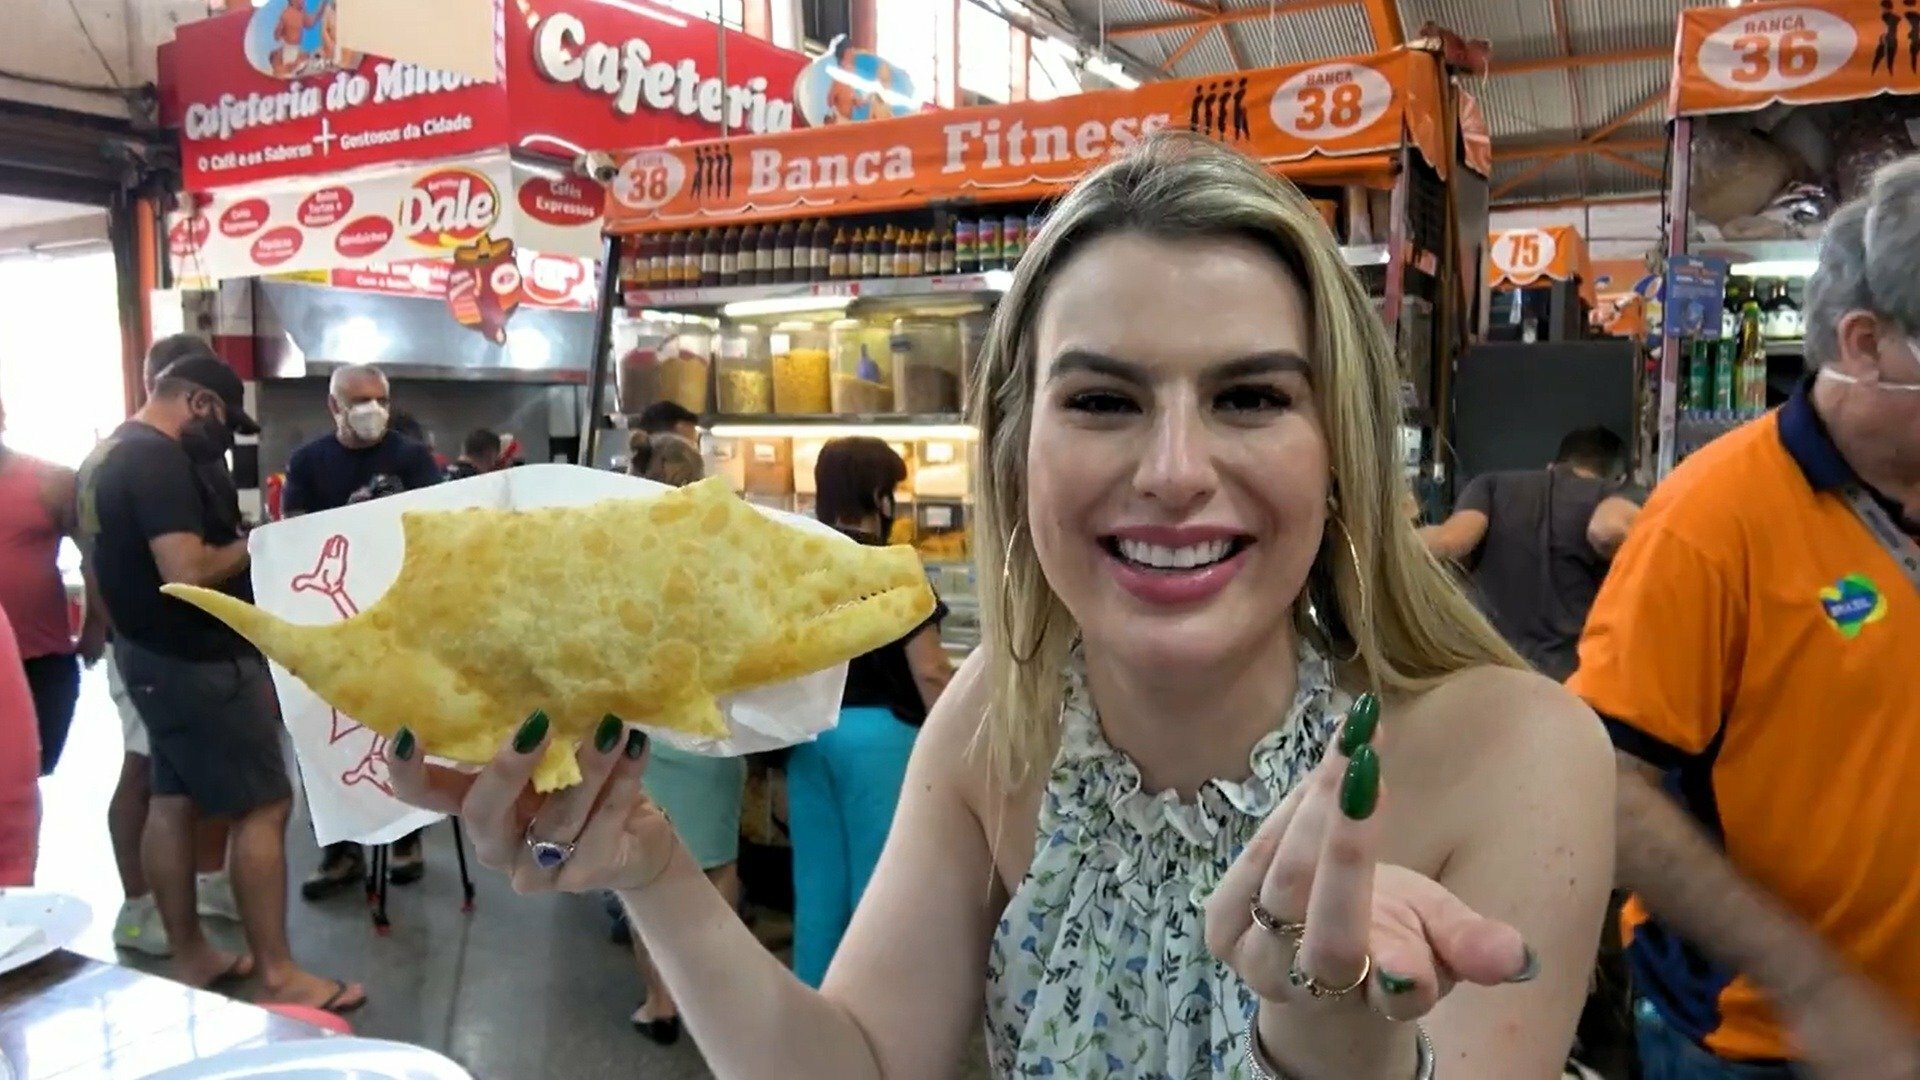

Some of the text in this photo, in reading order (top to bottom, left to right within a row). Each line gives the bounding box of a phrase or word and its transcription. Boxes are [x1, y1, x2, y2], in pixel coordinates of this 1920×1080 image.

[1743, 13, 1806, 34] BANCA
[533, 12, 793, 134] Cafeteria
[1730, 28, 1820, 82] 36
[185, 81, 321, 140] Cafeteria
[326, 71, 369, 113] do
[403, 122, 421, 140] da
[422, 113, 472, 136] Cidade
[1294, 83, 1363, 132] 38
[626, 167, 669, 203] 38
[748, 144, 916, 195] Banca
[401, 176, 495, 235] Dale
[1508, 234, 1541, 268] 75
